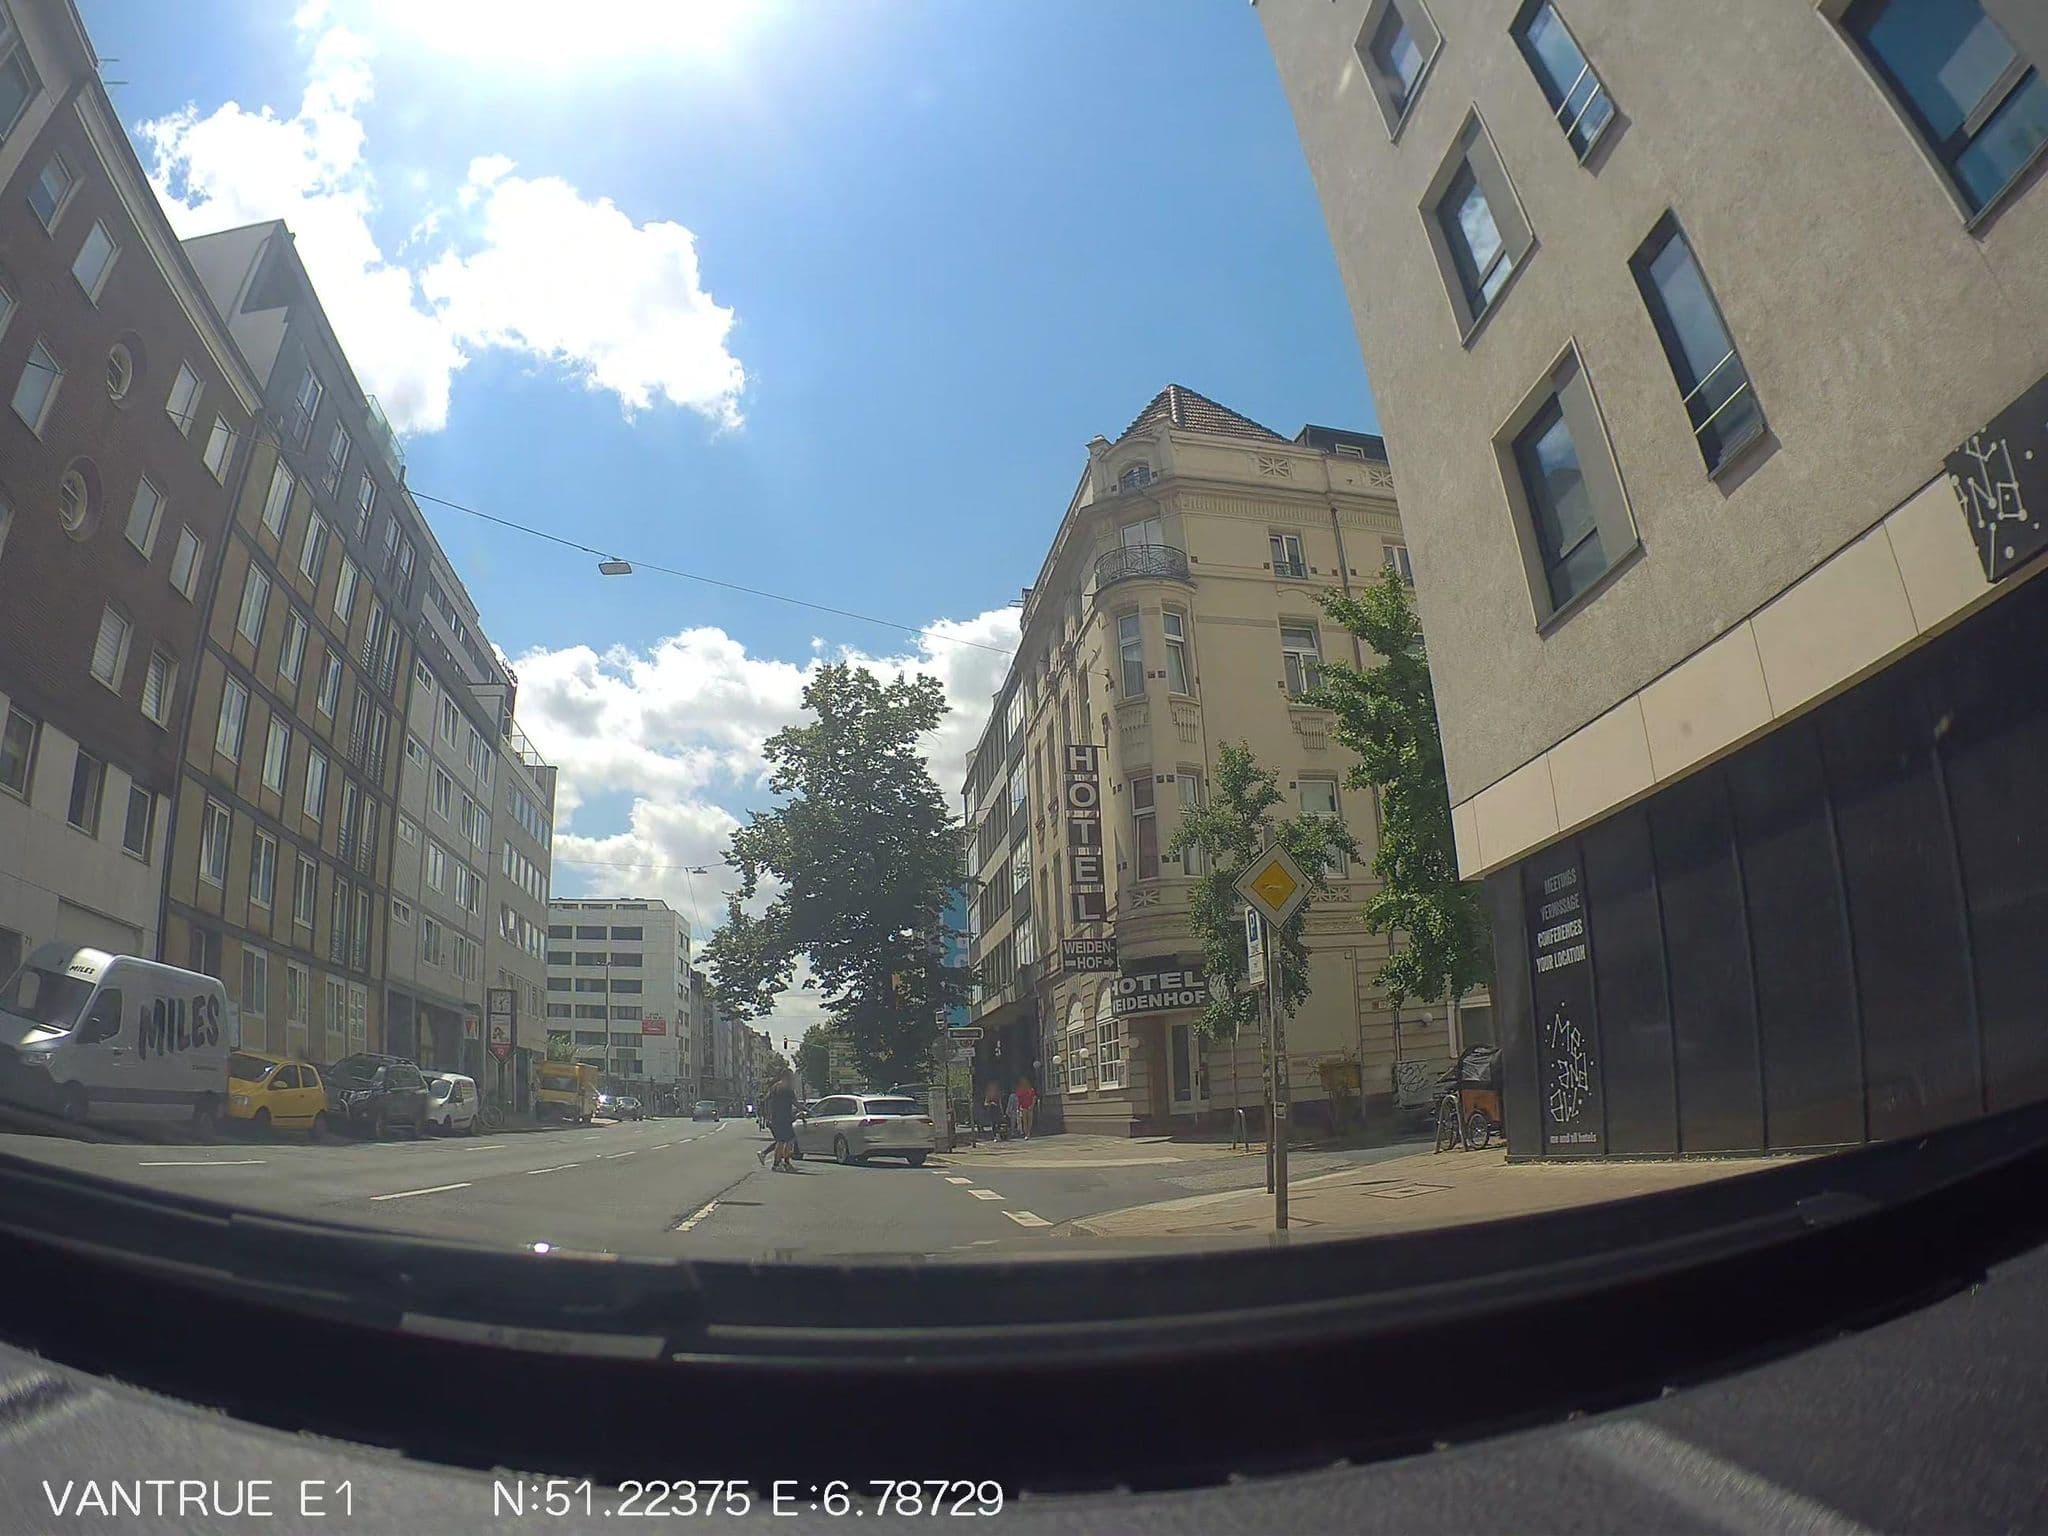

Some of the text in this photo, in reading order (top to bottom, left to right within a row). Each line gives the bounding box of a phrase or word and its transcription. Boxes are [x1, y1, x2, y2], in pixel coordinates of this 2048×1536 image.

[1069, 747, 1101, 920] HOTEL
[1537, 918, 1583, 947] CONFERENCES
[1064, 941, 1115, 954] WEIDEN-
[1536, 944, 1586, 973] YOUR LOCATION
[69, 965, 96, 975] MILES
[1077, 956, 1102, 969] HOF
[1113, 990, 1206, 1014] EIDENHOF
[139, 993, 219, 1060] MILES
